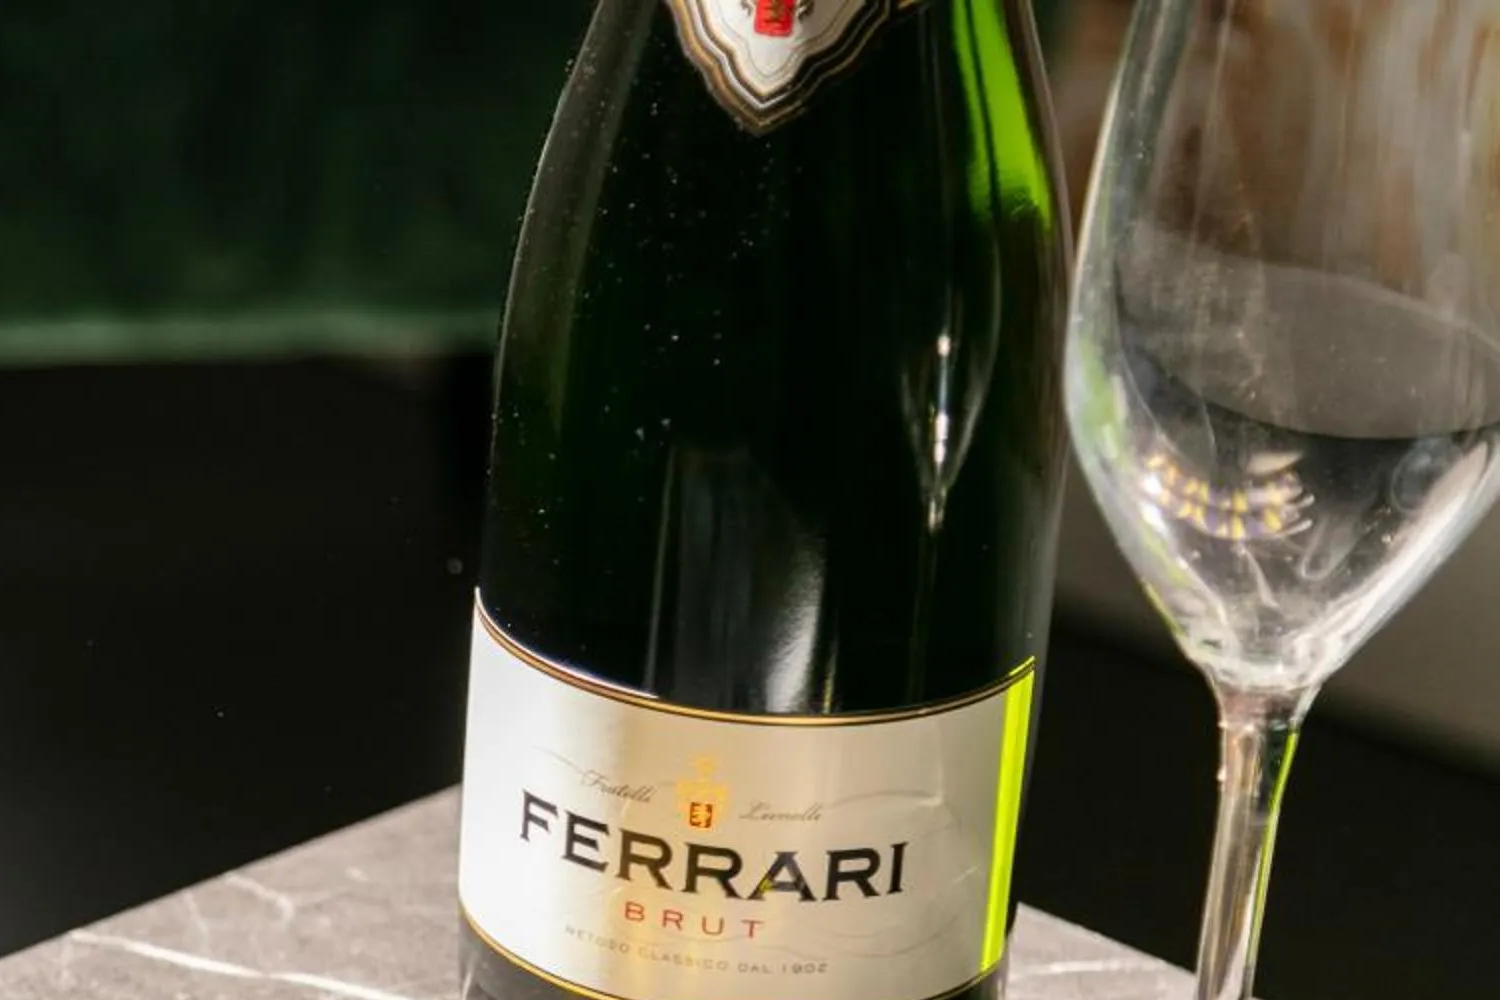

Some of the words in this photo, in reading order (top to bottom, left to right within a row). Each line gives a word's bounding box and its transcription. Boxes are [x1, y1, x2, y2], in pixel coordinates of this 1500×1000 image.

[519, 789, 910, 902] FERRARI
[624, 901, 763, 939] BRUT
[736, 961, 772, 974] DAL
